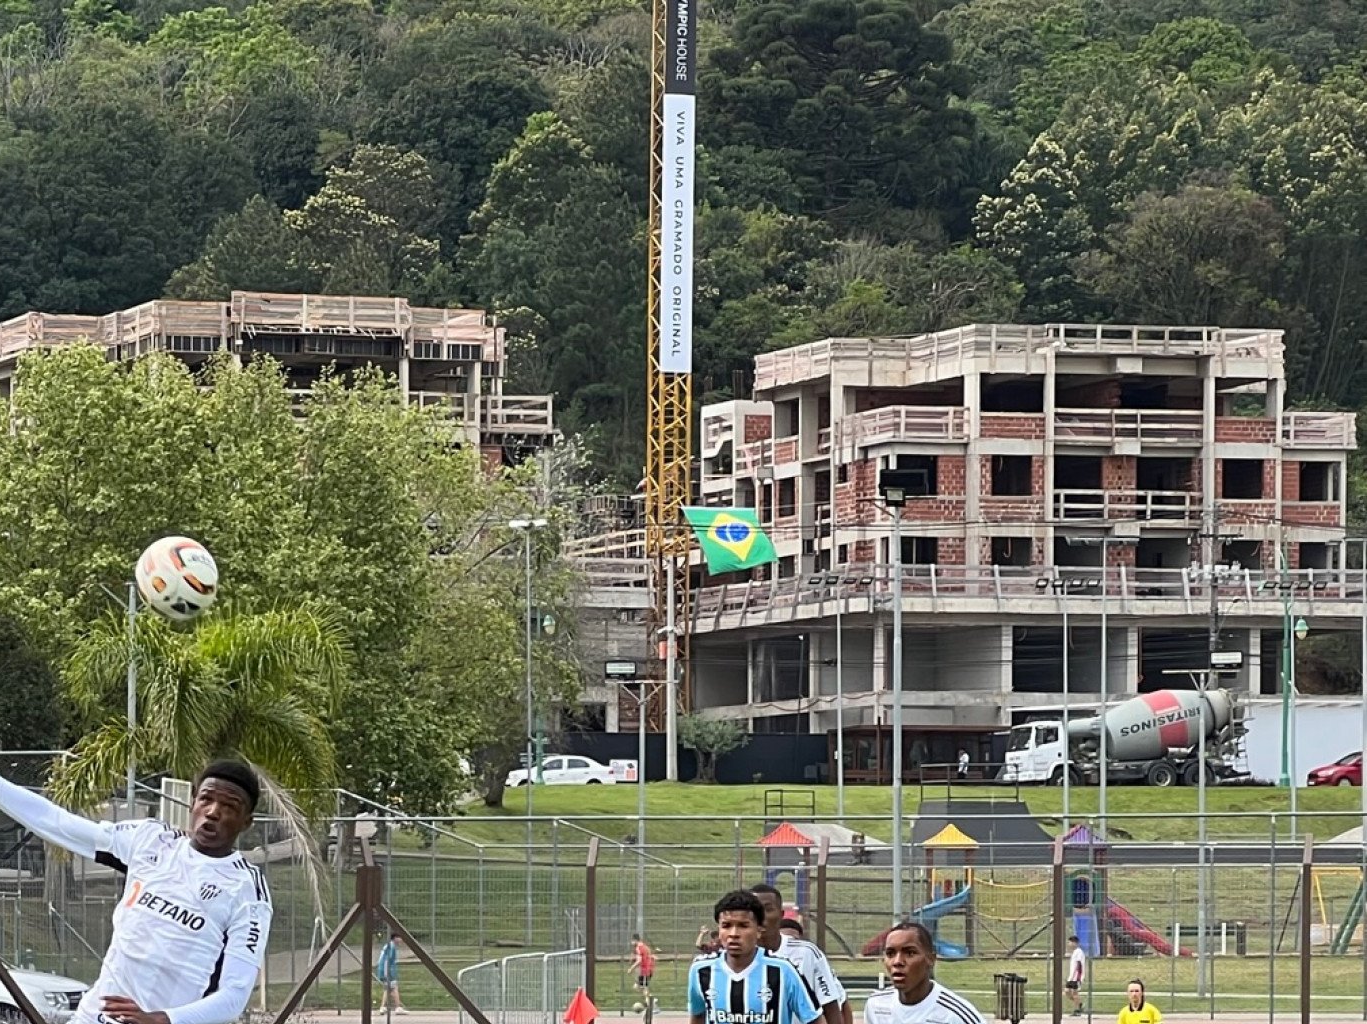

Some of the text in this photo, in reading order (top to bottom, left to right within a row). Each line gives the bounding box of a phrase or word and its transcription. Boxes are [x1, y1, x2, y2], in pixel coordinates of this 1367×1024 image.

[676, 38, 688, 81] HOUSE
[671, 110, 686, 357] VIVA UMA GRAMADO ORIGINAL
[137, 891, 206, 932] BETANO
[245, 920, 261, 954] MRV
[717, 1008, 774, 1024] Banrisul
